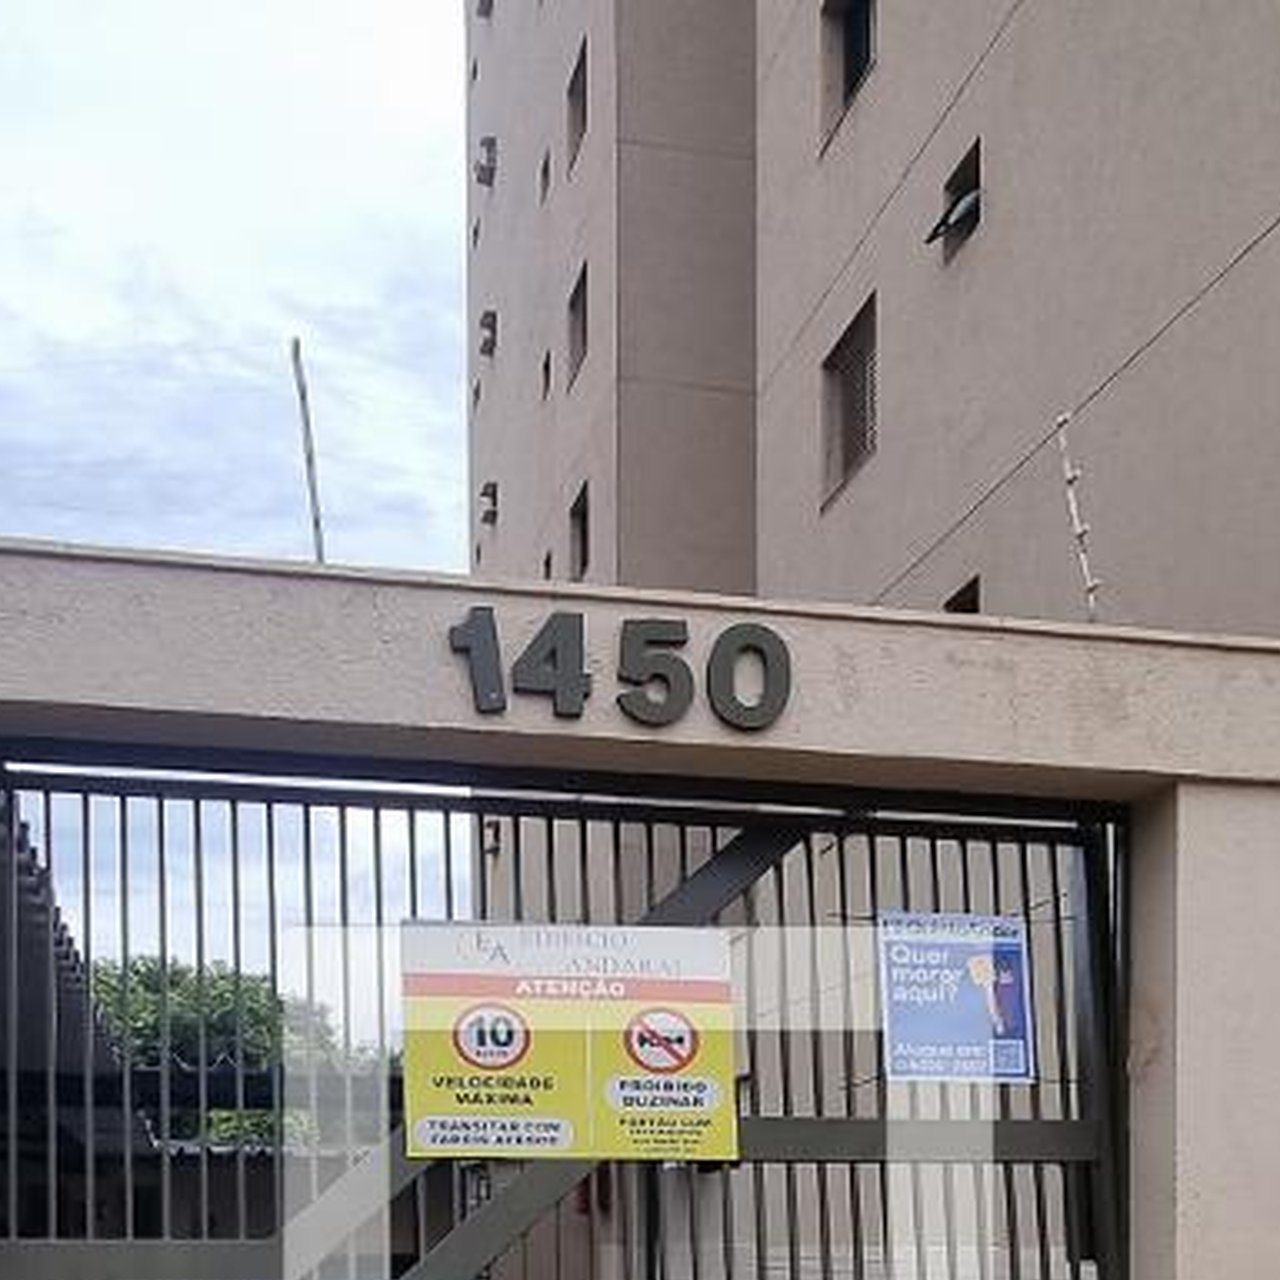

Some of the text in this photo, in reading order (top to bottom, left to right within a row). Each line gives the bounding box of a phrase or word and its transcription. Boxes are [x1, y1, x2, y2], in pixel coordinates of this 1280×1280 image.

[449, 606, 792, 732] 1450
[515, 978, 625, 998] ATENÇÃO
[893, 982, 958, 1006] aqui?
[468, 1015, 515, 1048] 10
[431, 1075, 555, 1091] VELOCIDADE
[619, 1079, 708, 1094] PROIBIDO
[622, 1096, 705, 1108] BUZINAR
